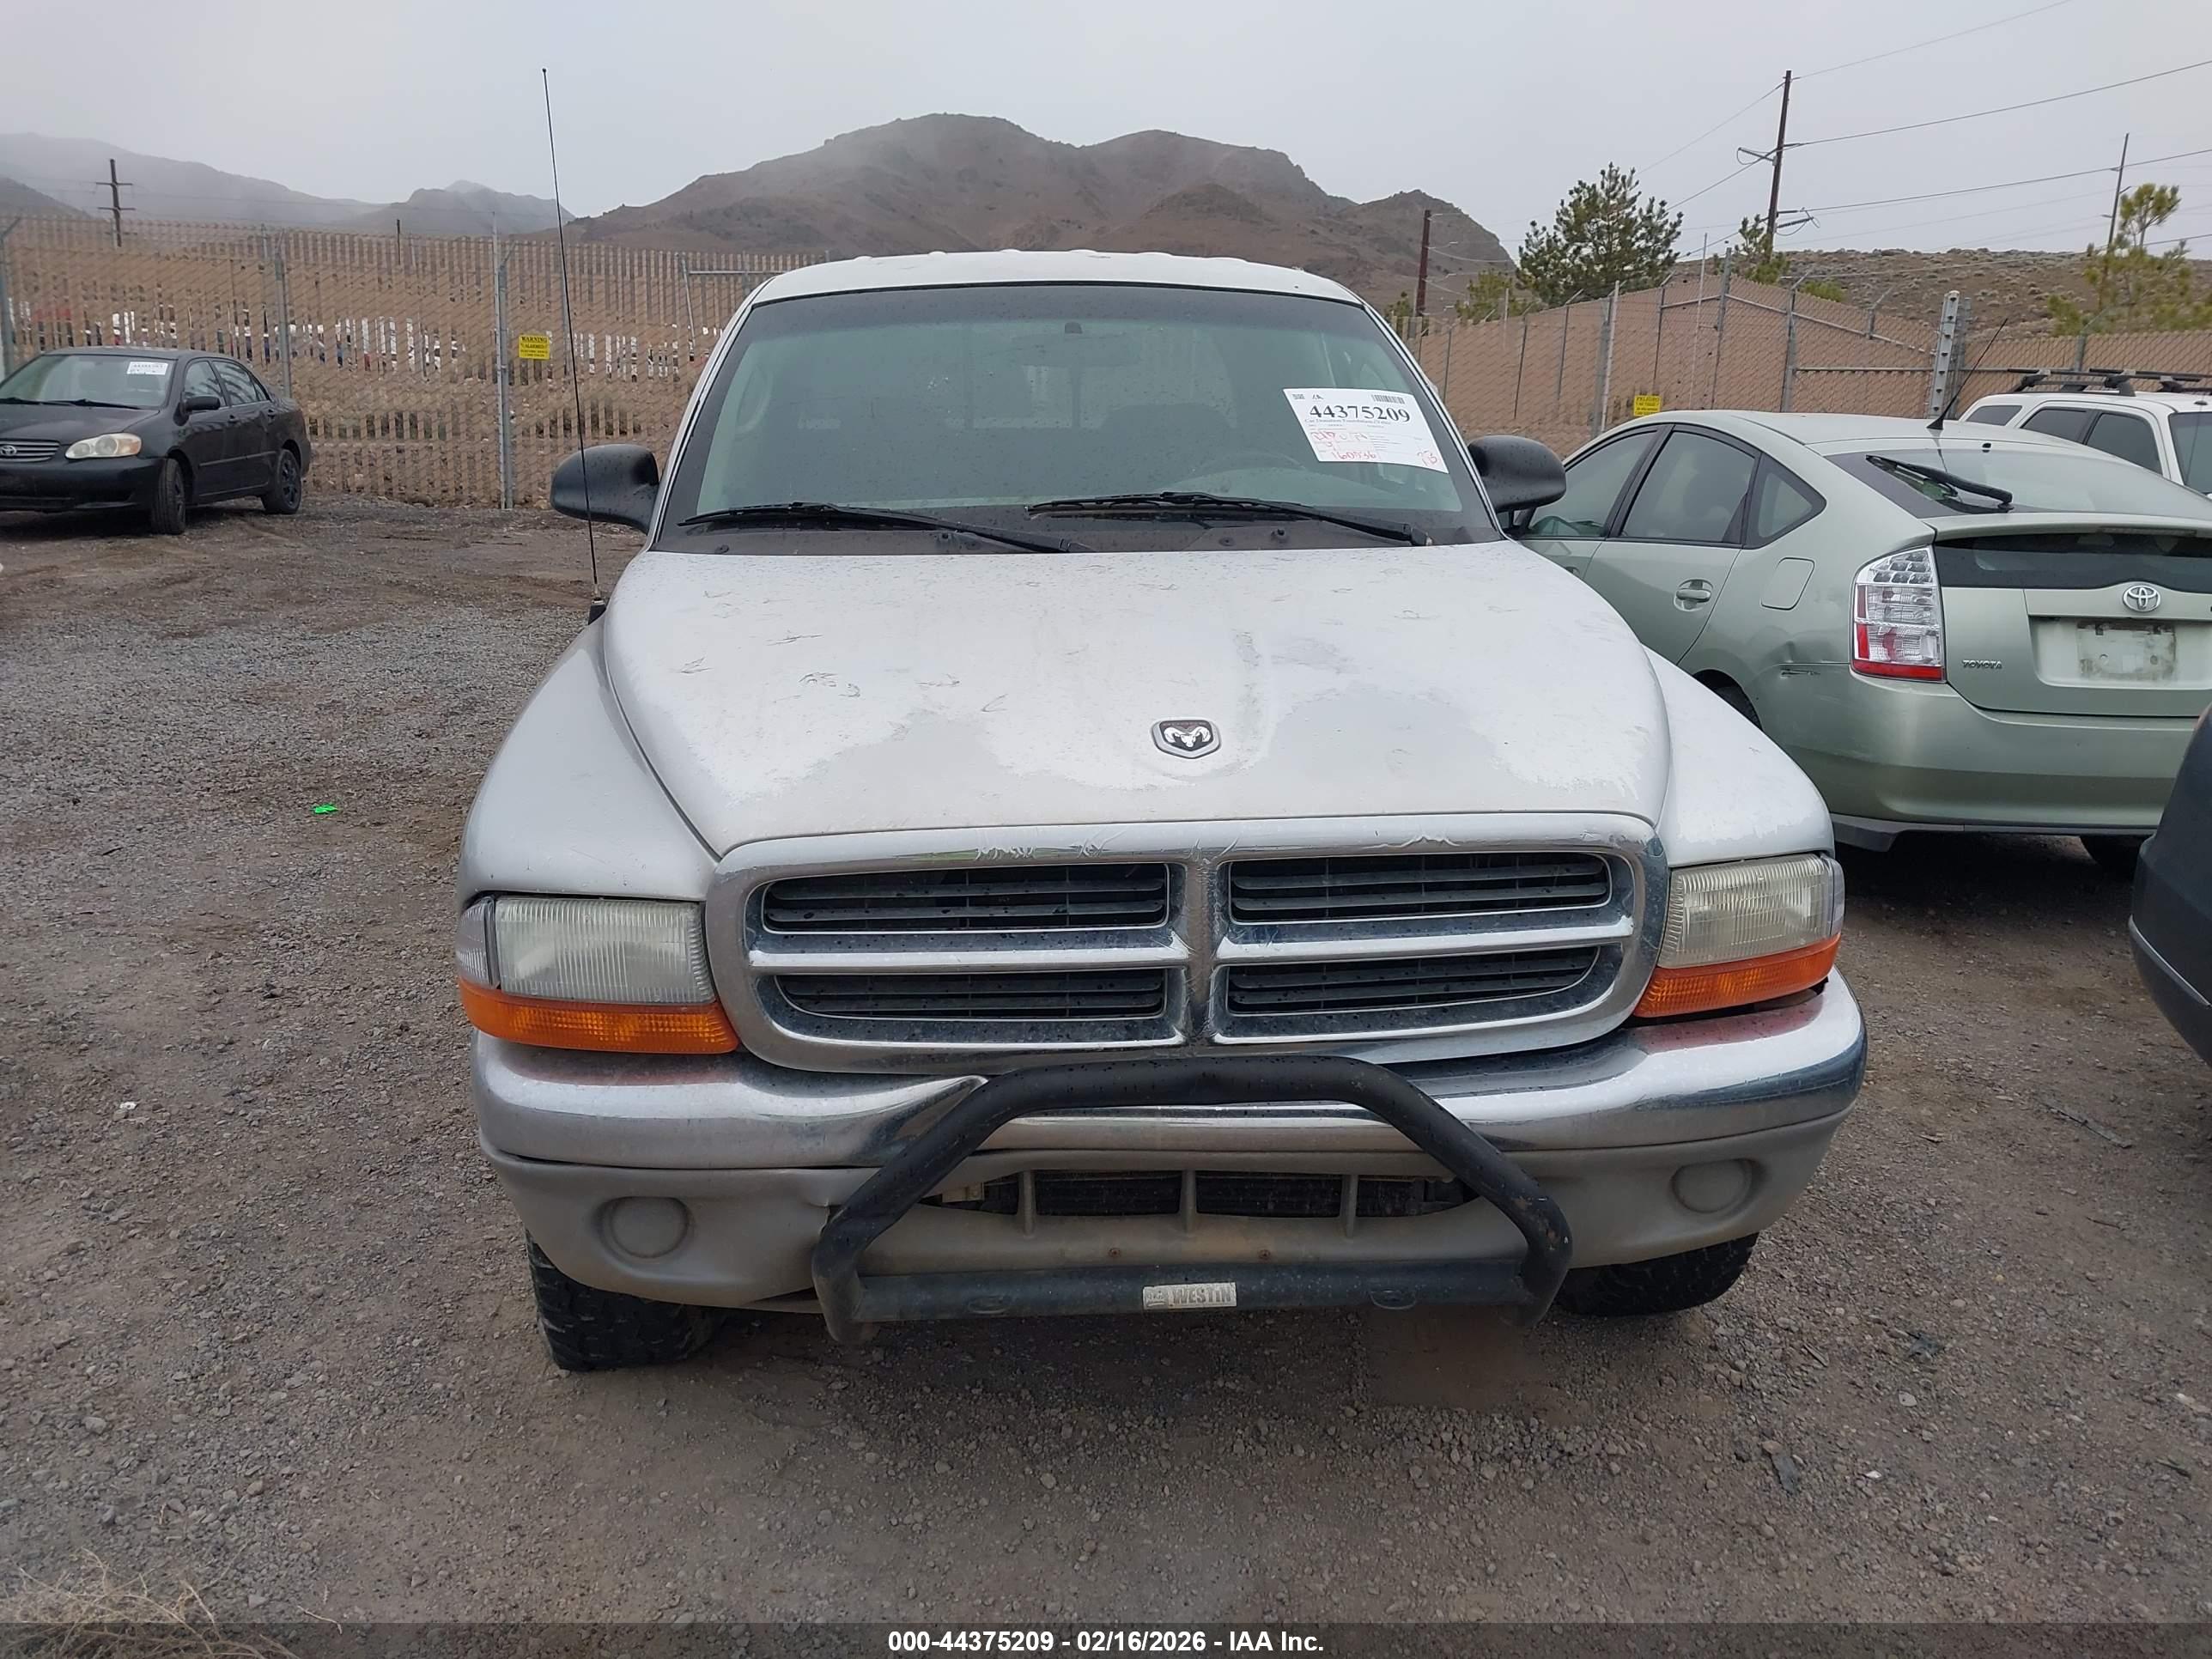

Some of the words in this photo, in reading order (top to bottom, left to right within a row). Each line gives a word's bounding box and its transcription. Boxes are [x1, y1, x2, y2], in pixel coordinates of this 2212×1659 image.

[1310, 404, 1410, 422] 44375209
[1962, 659, 2002, 670] TOYOTA
[1172, 1285, 1231, 1304] WESTIN
